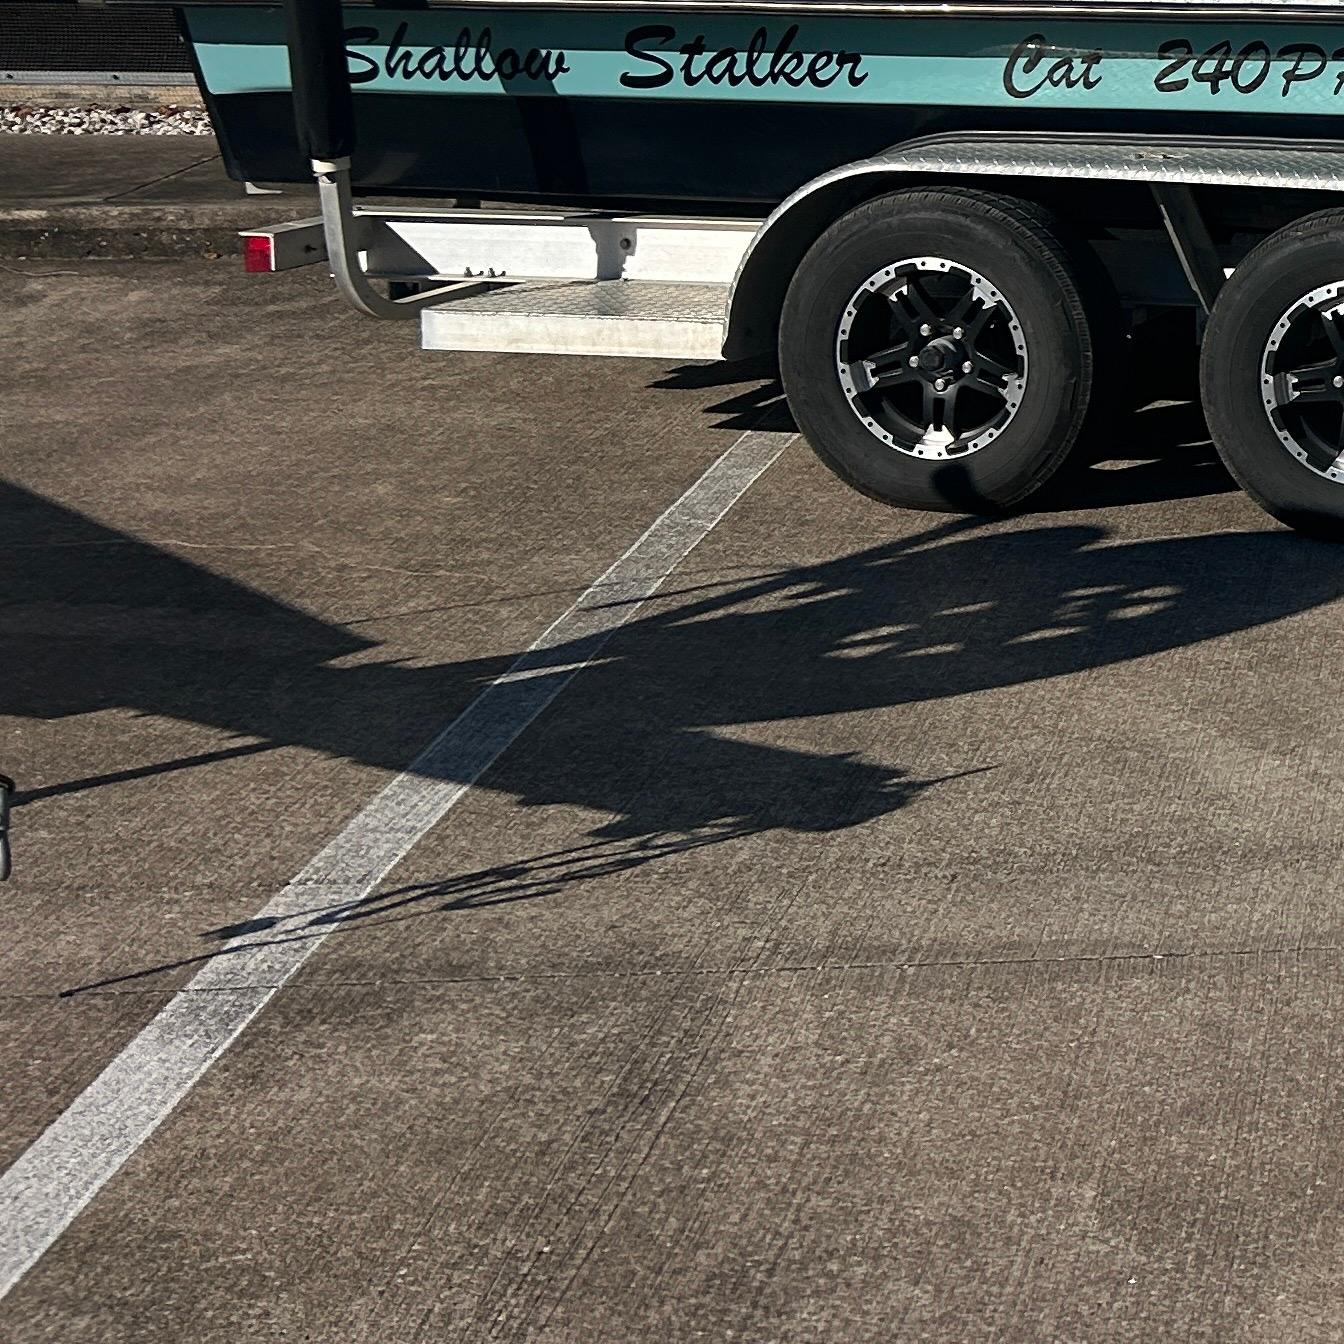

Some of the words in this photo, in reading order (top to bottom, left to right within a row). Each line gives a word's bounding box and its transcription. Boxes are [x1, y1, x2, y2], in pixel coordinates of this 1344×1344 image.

[343, 22, 571, 85] Shallow
[619, 23, 870, 90] Stalker
[1002, 33, 1103, 99] Cat
